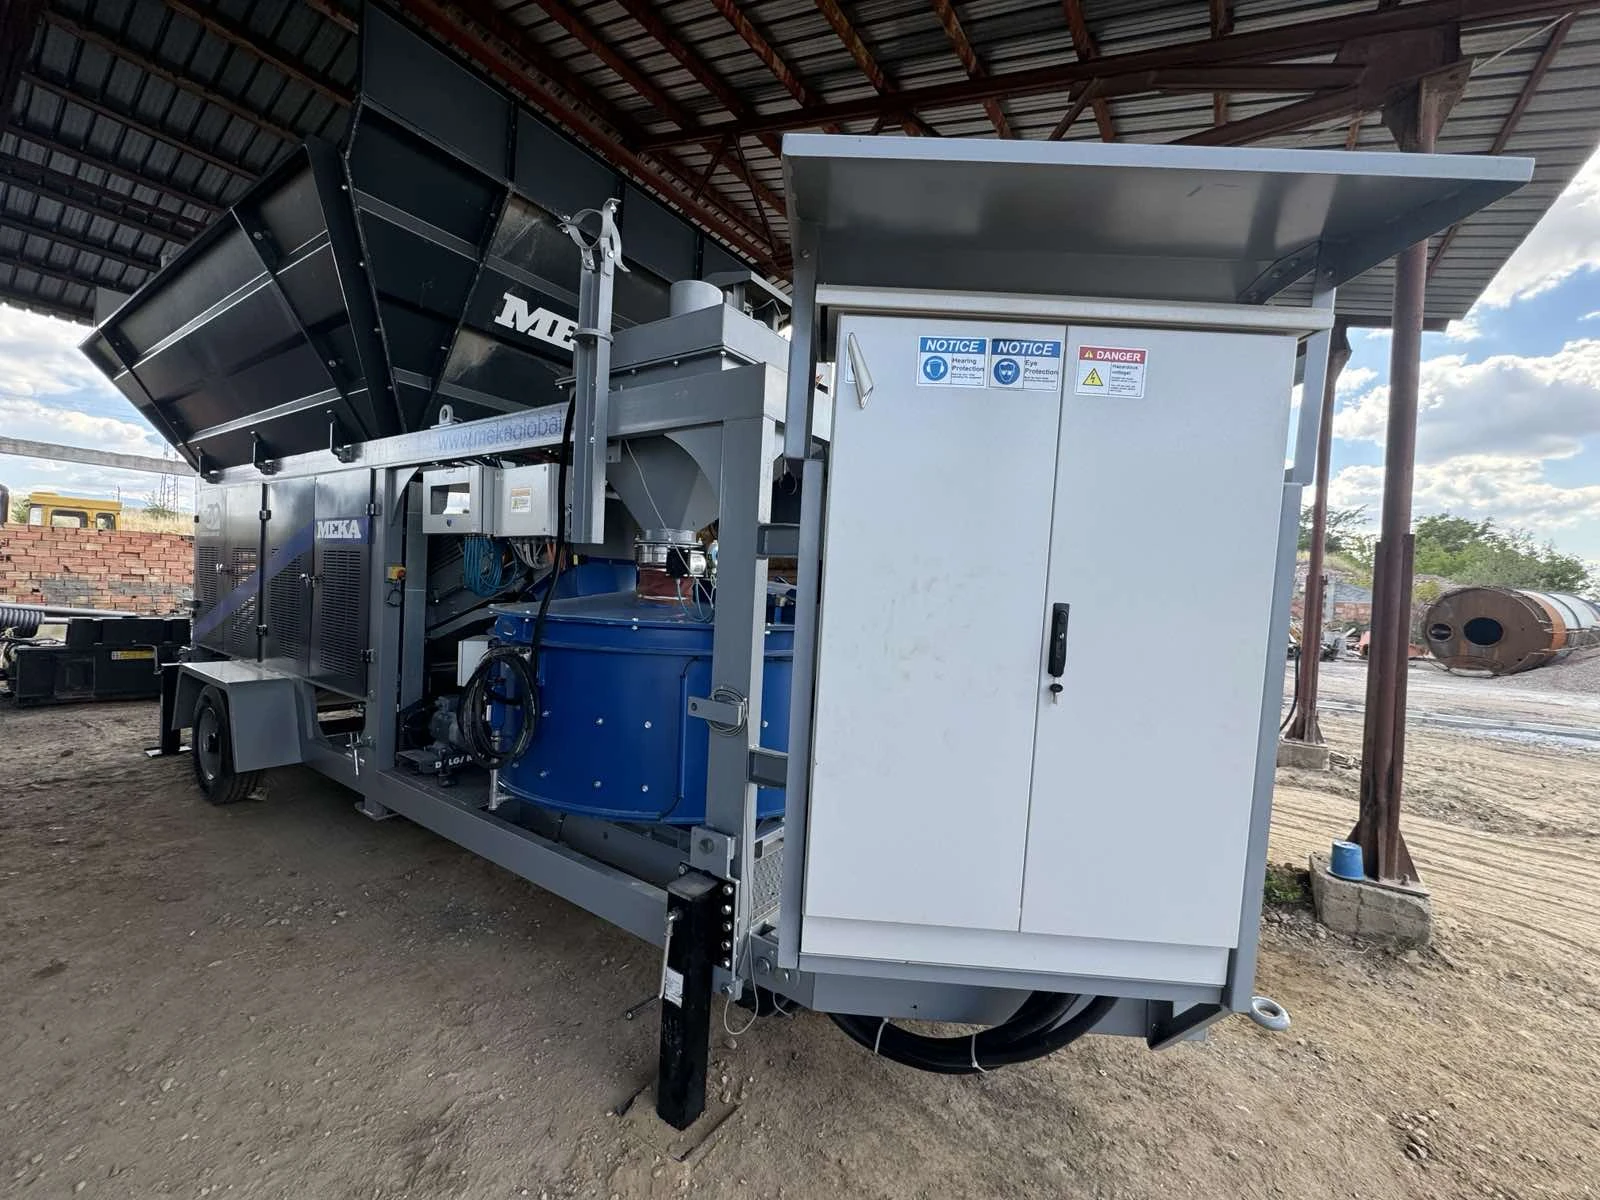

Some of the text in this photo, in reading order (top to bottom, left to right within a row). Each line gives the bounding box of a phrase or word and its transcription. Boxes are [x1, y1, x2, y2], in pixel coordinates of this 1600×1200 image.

[925, 339, 980, 352] NOTICE
[997, 341, 1053, 356] NOTICE
[952, 357, 977, 365] Hearing
[1096, 350, 1141, 362] DANGER
[1025, 368, 1059, 376] Protection
[317, 520, 362, 539] MEKA
